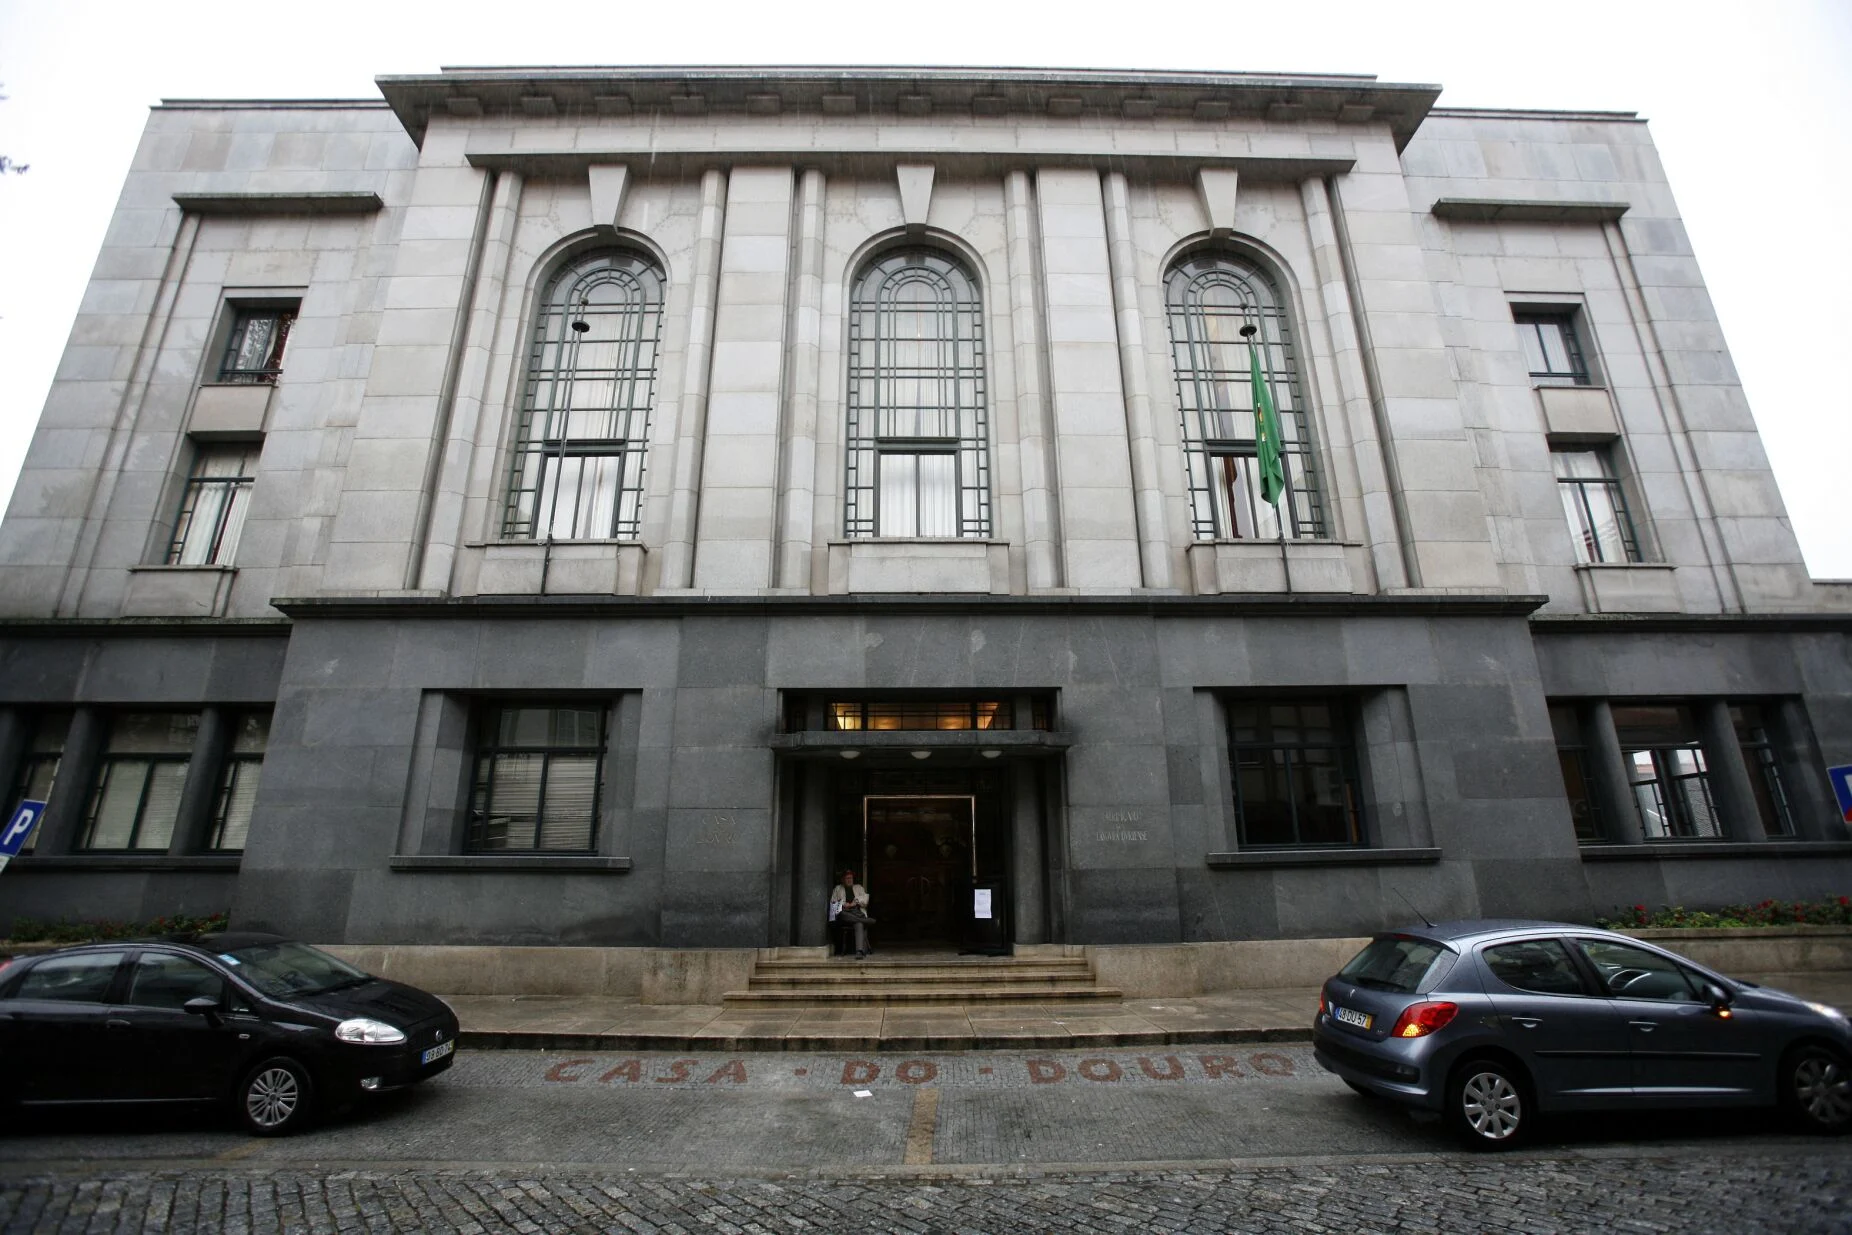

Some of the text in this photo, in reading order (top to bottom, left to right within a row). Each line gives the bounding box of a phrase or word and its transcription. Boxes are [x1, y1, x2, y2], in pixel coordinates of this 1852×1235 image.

[3, 808, 34, 846] P
[545, 1052, 1296, 1085] CASA DO DOURO
